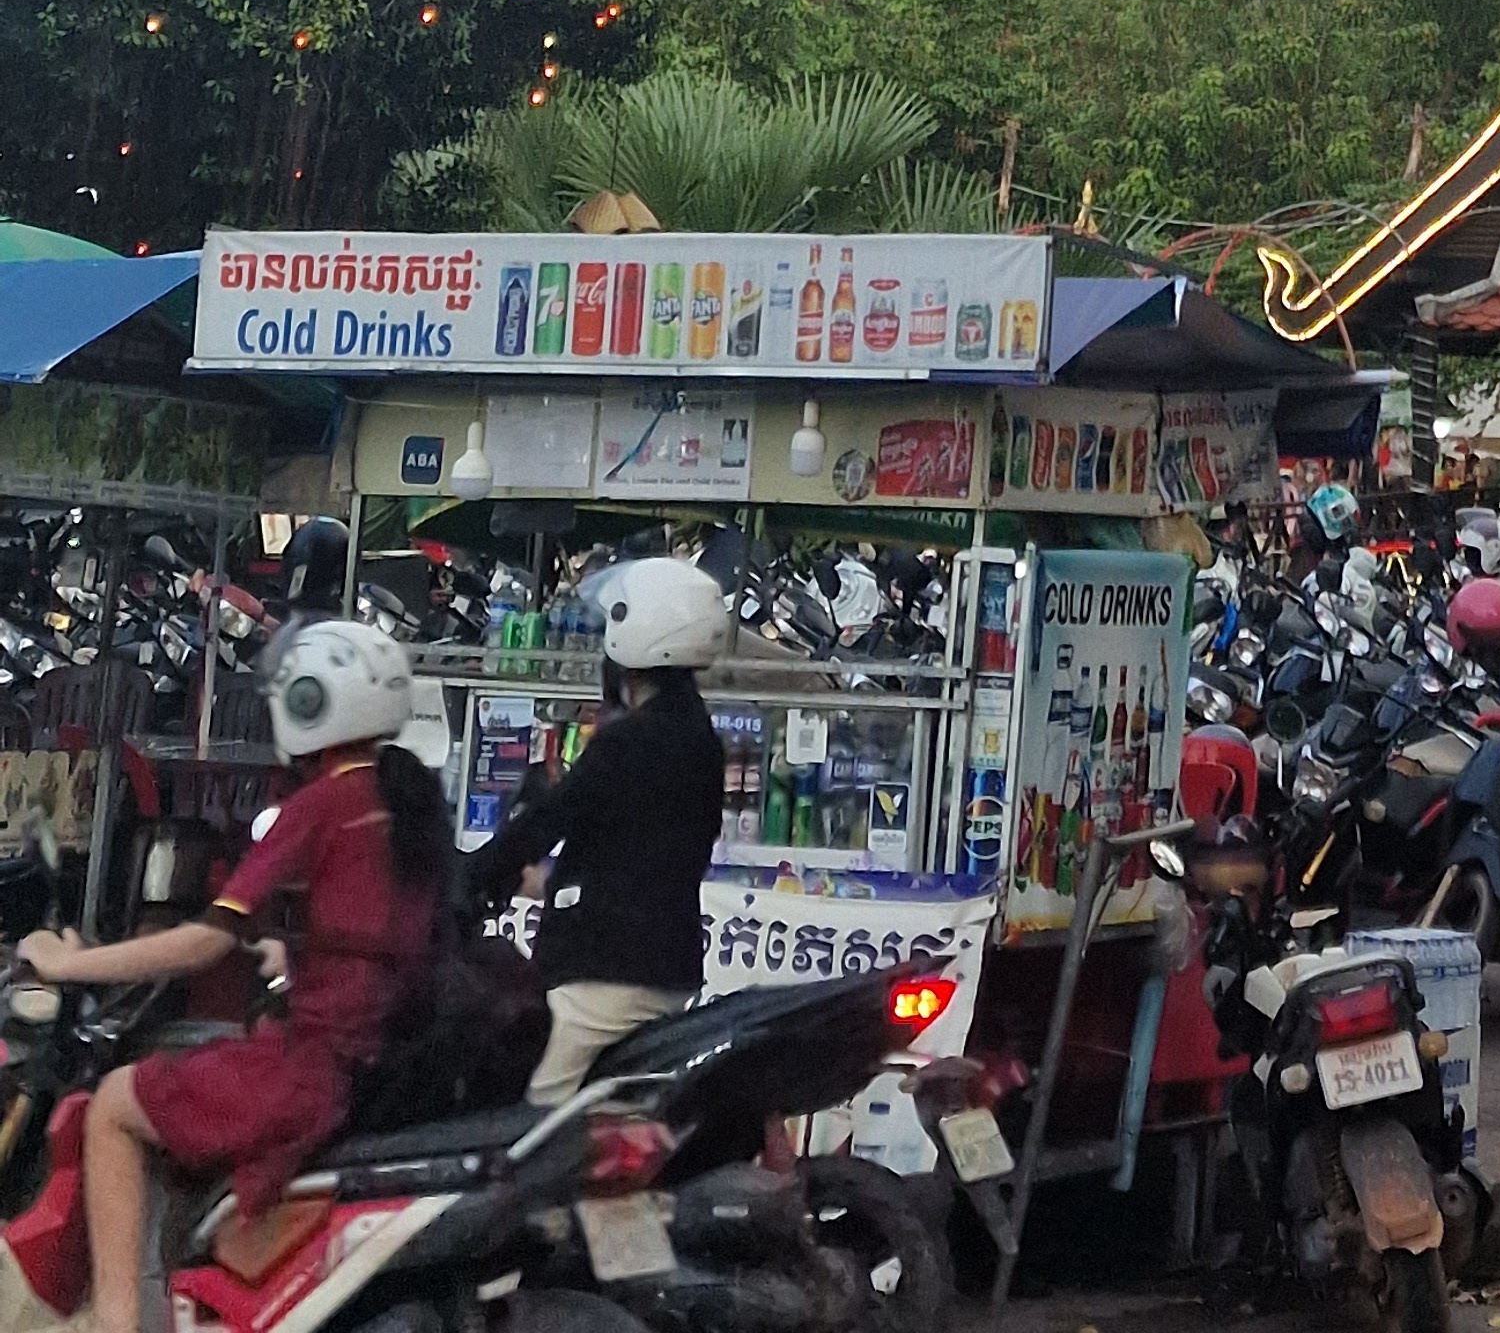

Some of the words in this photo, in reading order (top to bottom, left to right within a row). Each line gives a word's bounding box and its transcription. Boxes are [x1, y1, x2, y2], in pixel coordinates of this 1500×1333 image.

[237, 308, 318, 355] Cold
[333, 309, 453, 357] Drinks
[406, 452, 439, 469] ABA
[1043, 582, 1094, 625] COLD
[1099, 584, 1173, 626] DRINKS
